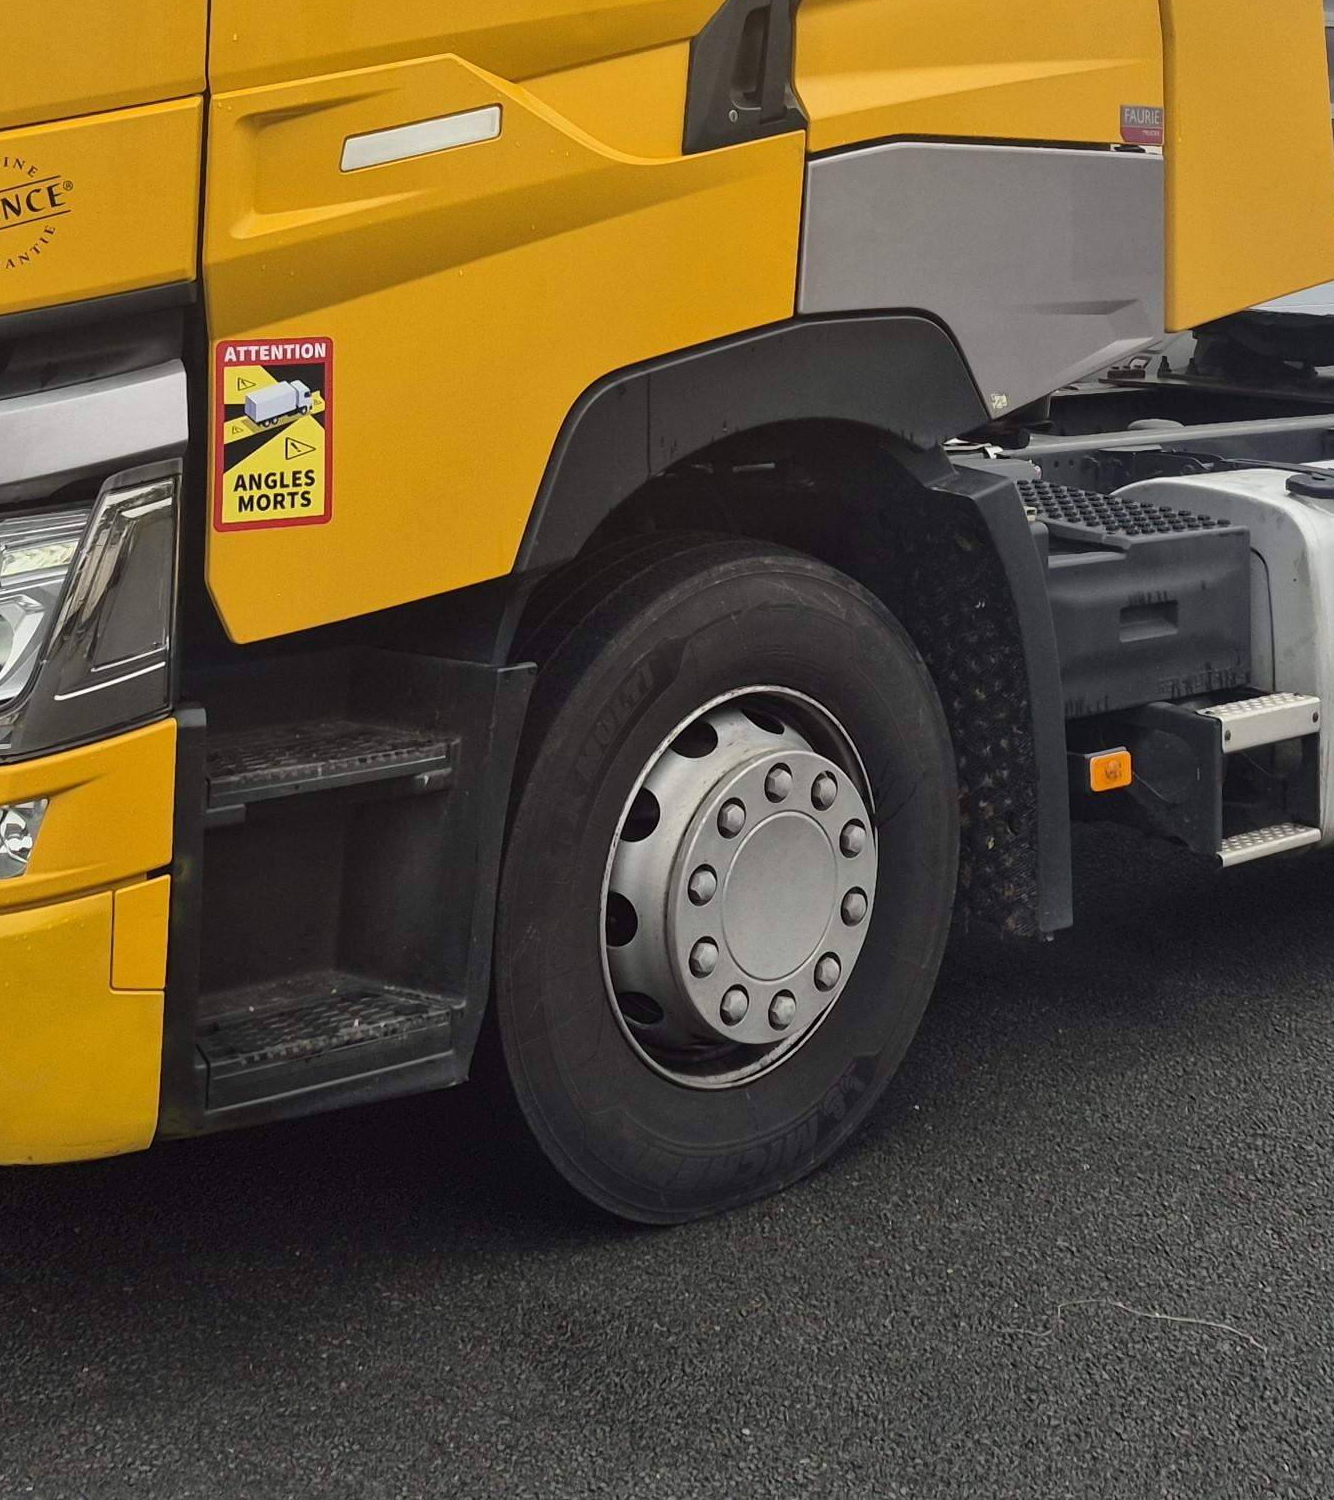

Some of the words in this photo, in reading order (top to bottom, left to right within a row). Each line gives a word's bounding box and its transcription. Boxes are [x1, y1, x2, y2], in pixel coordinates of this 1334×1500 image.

[1124, 108, 1160, 124] FAURIE
[224, 343, 327, 362] ATTENTION
[233, 469, 316, 492] ANGLES
[238, 490, 312, 513] MORTS
